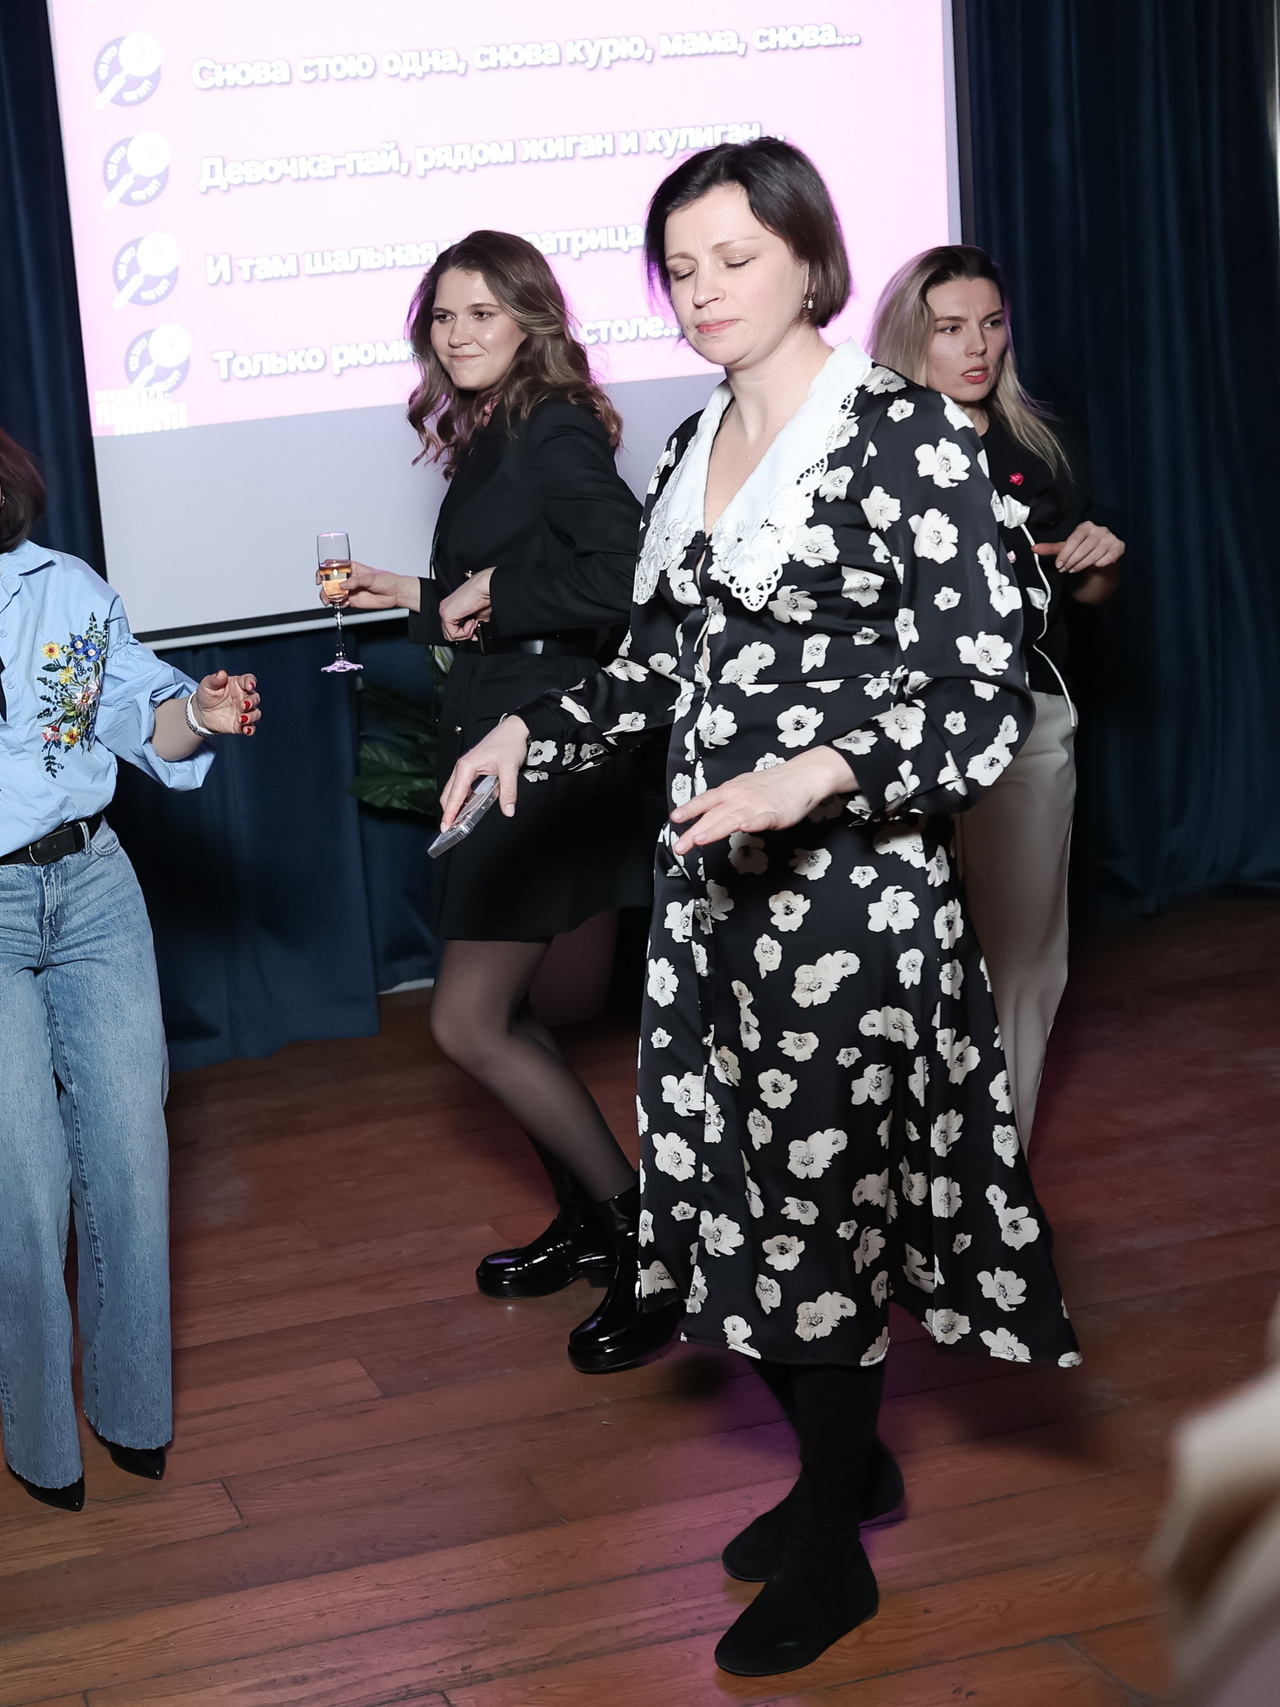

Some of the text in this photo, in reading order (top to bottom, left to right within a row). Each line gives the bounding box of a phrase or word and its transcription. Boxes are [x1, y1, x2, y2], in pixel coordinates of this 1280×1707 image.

[191, 23, 861, 89] Снова стою одна, снова курю, мама, снова...
[198, 141, 410, 192] Девочка-пай,
[415, 140, 516, 177] рядом
[520, 133, 614, 162] жиган
[620, 131, 639, 154] и
[206, 254, 232, 284] И
[236, 254, 298, 281] там
[304, 241, 437, 276] шальная
[212, 347, 325, 380] Только
